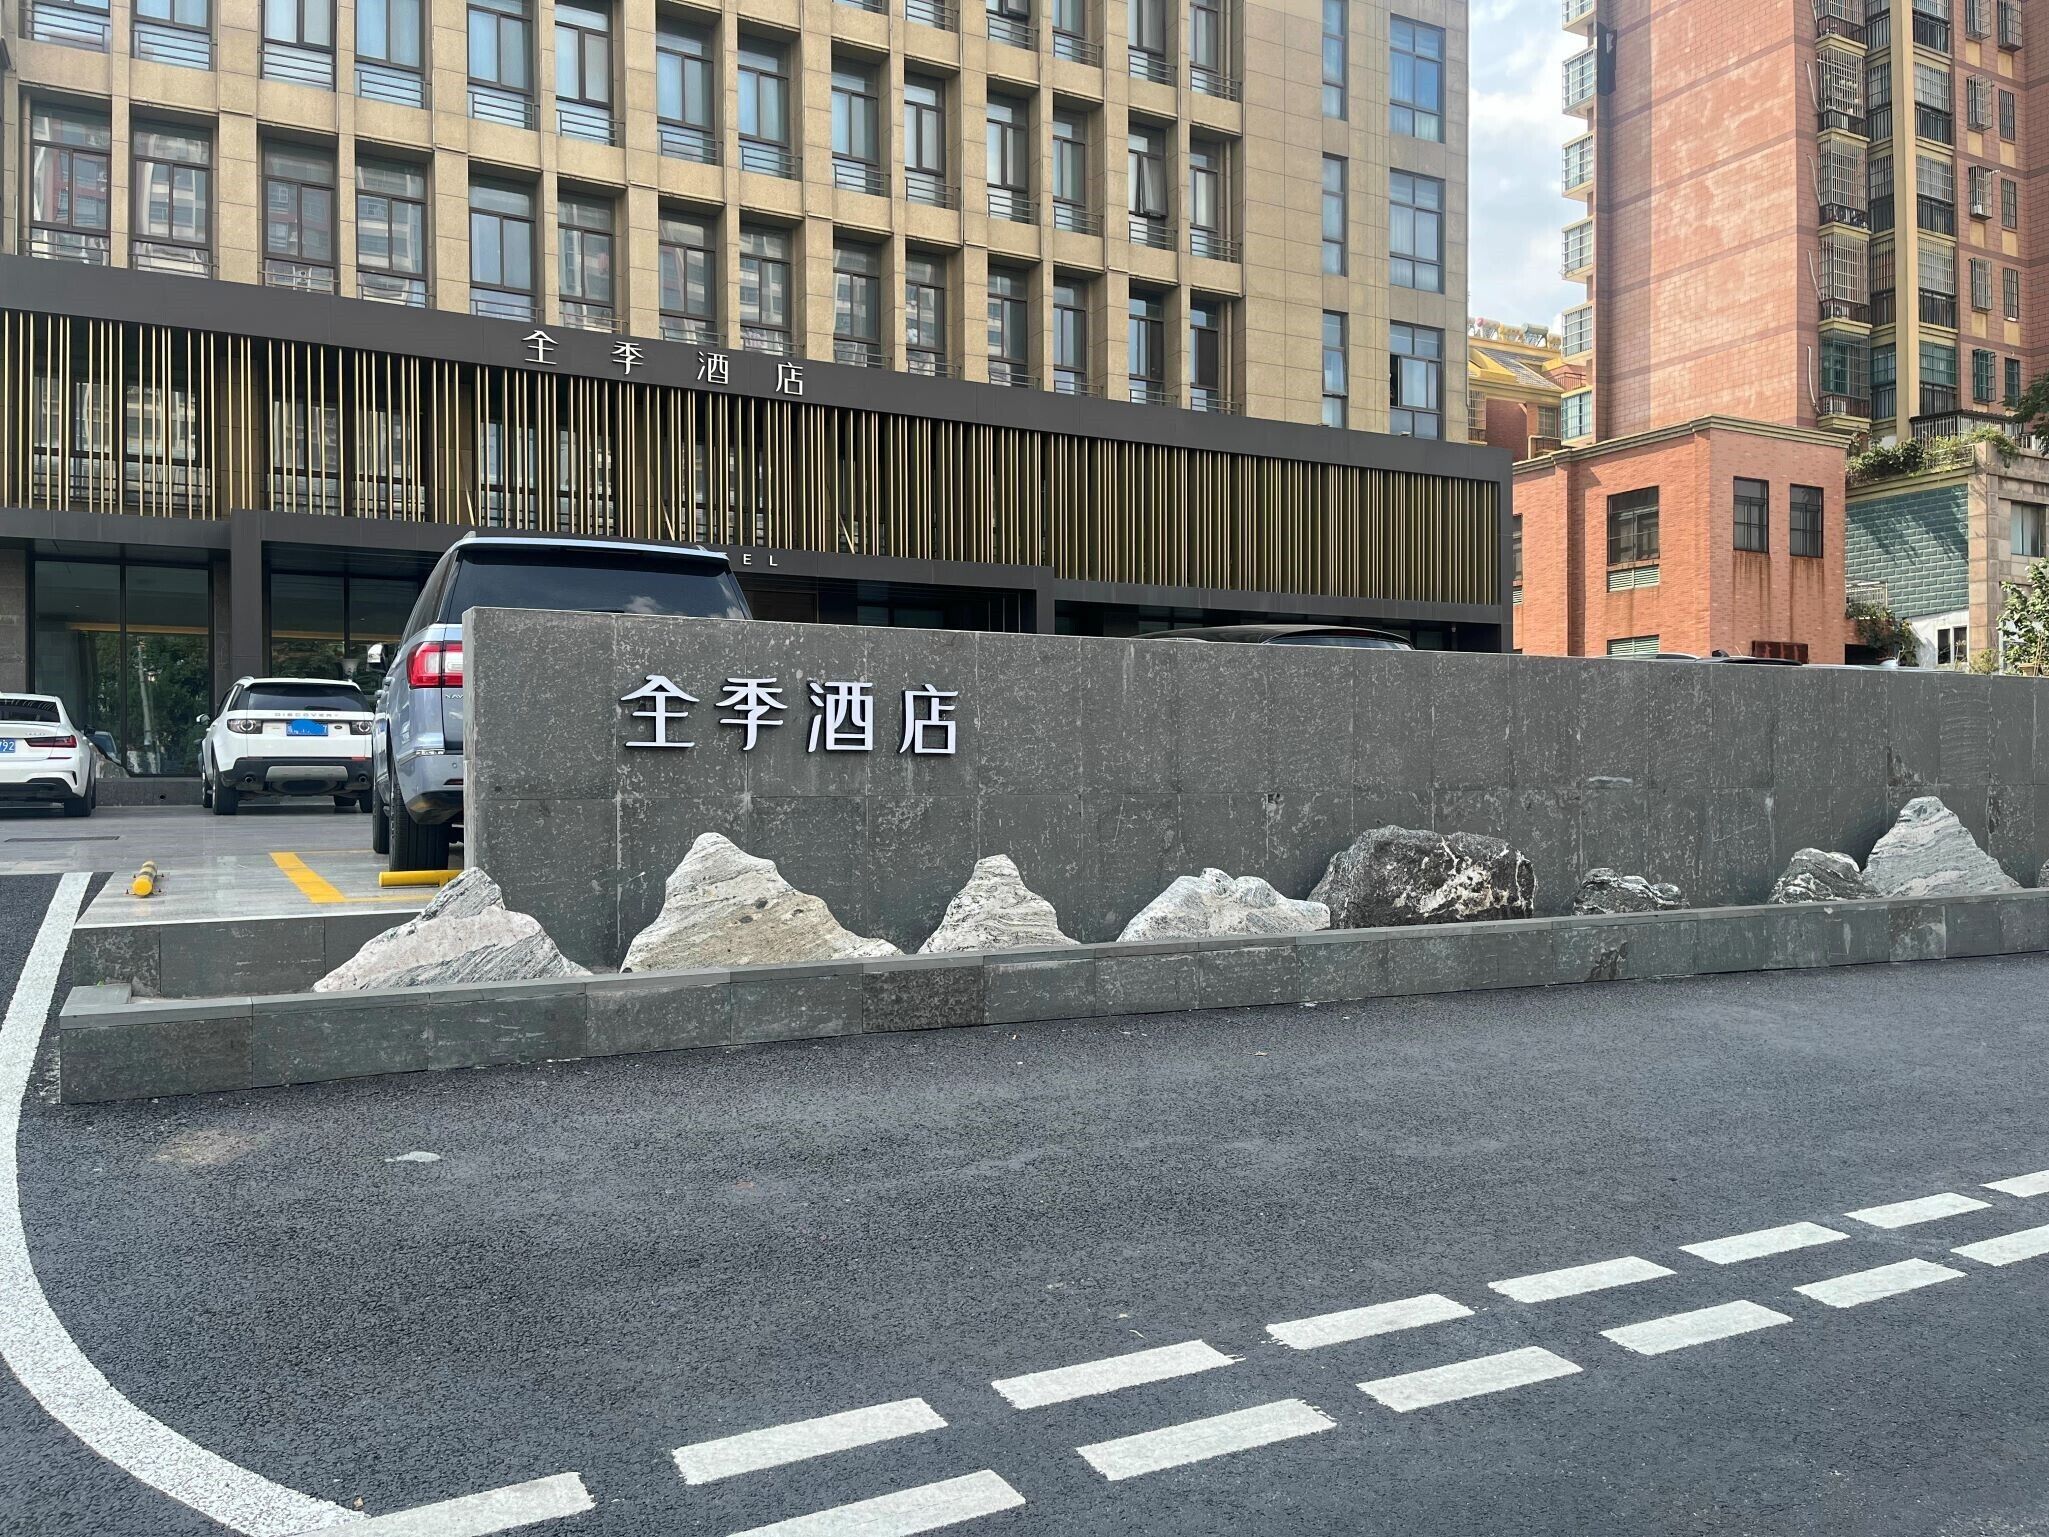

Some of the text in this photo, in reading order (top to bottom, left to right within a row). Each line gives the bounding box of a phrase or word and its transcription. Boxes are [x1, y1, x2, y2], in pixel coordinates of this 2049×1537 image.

[522, 330, 804, 396] 全季酒店
[621, 675, 959, 754] 全季酒店
